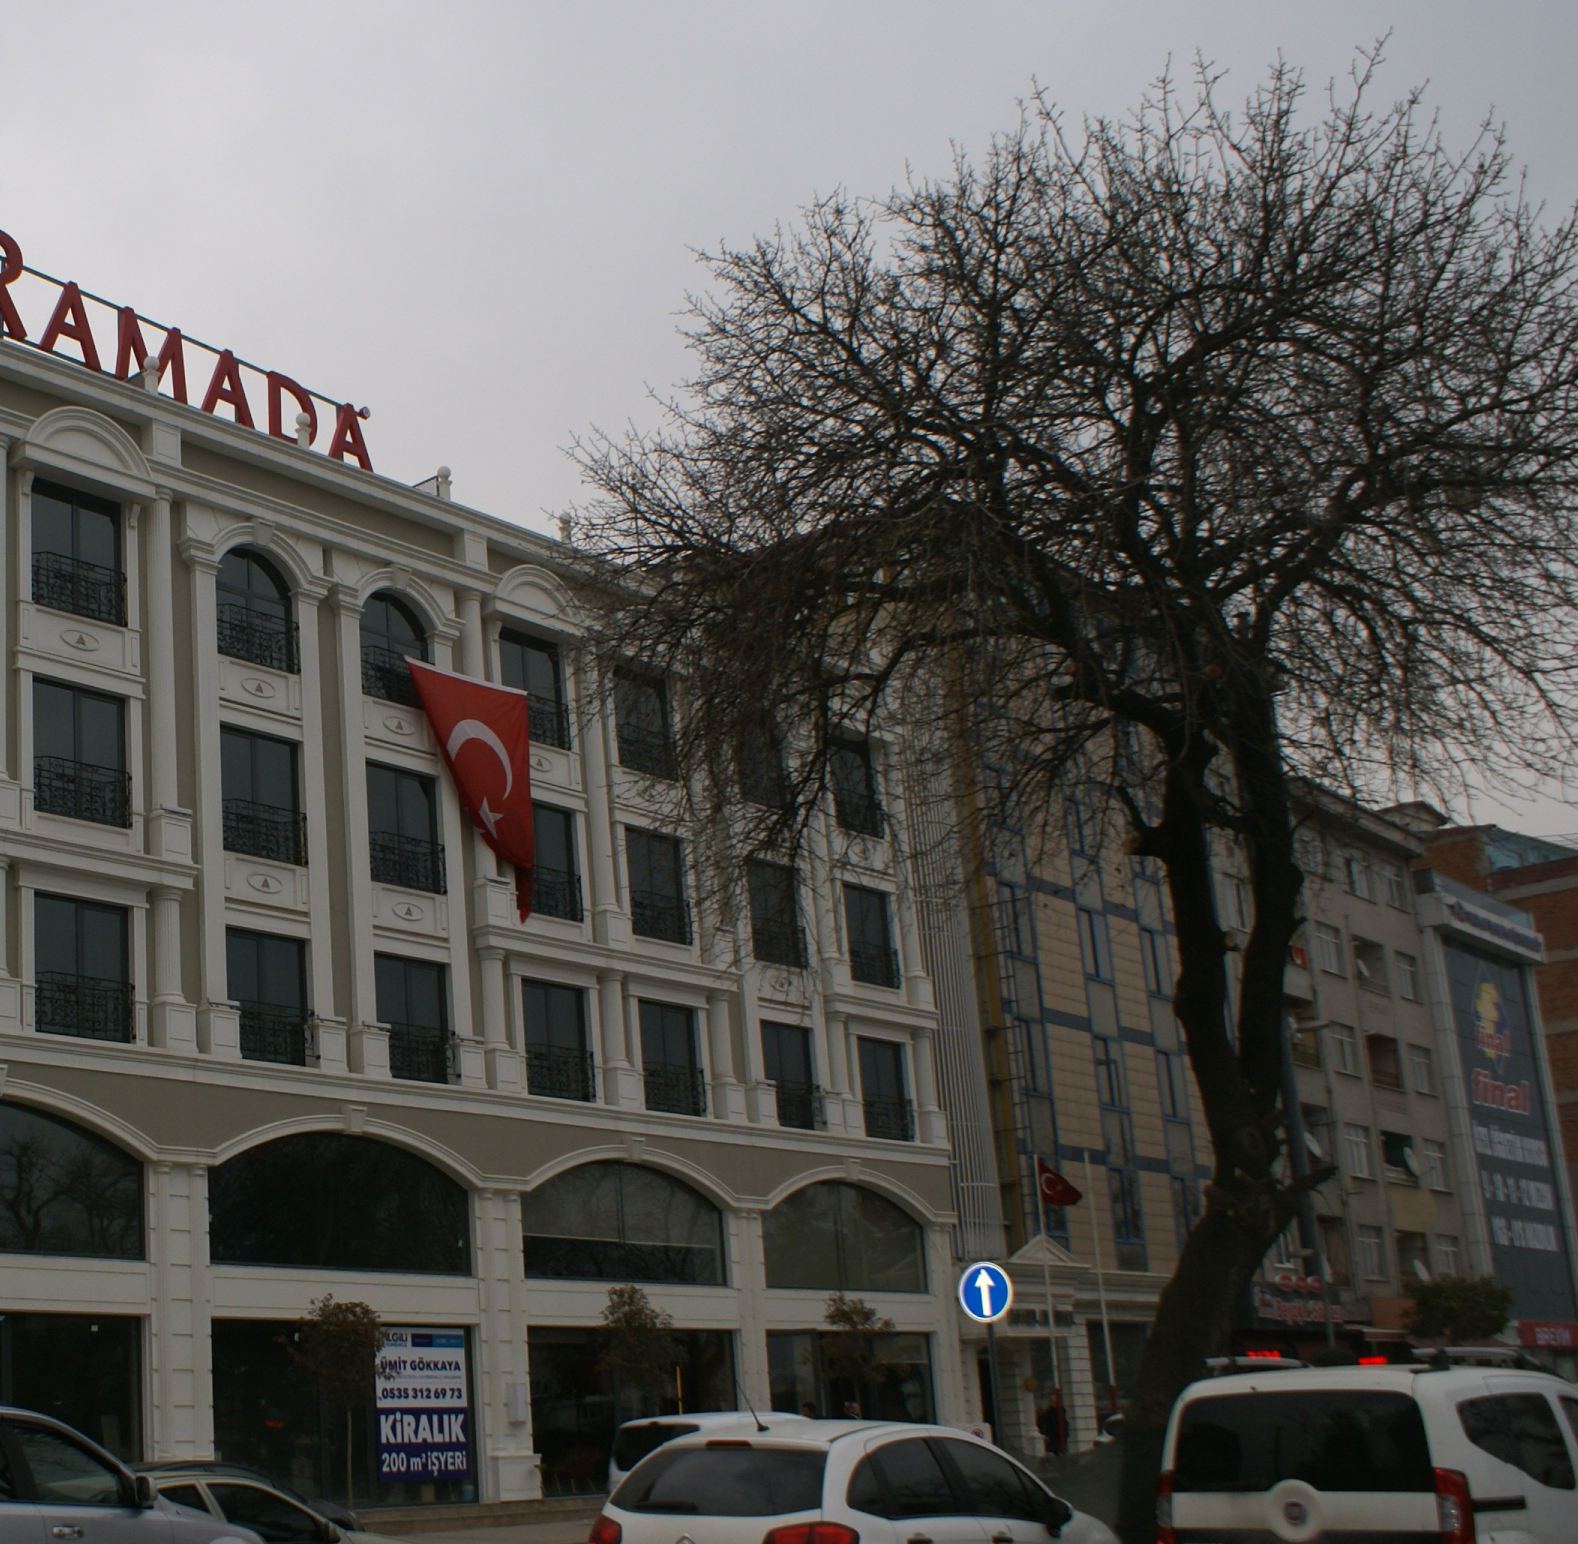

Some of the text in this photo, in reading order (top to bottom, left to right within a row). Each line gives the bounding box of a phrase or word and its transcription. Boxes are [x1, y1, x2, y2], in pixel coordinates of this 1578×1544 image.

[380, 1356, 462, 1372] ÜMİT GÖKKAYA
[381, 1387, 462, 1399] 0535 312 69 73
[381, 1452, 407, 1472] 200
